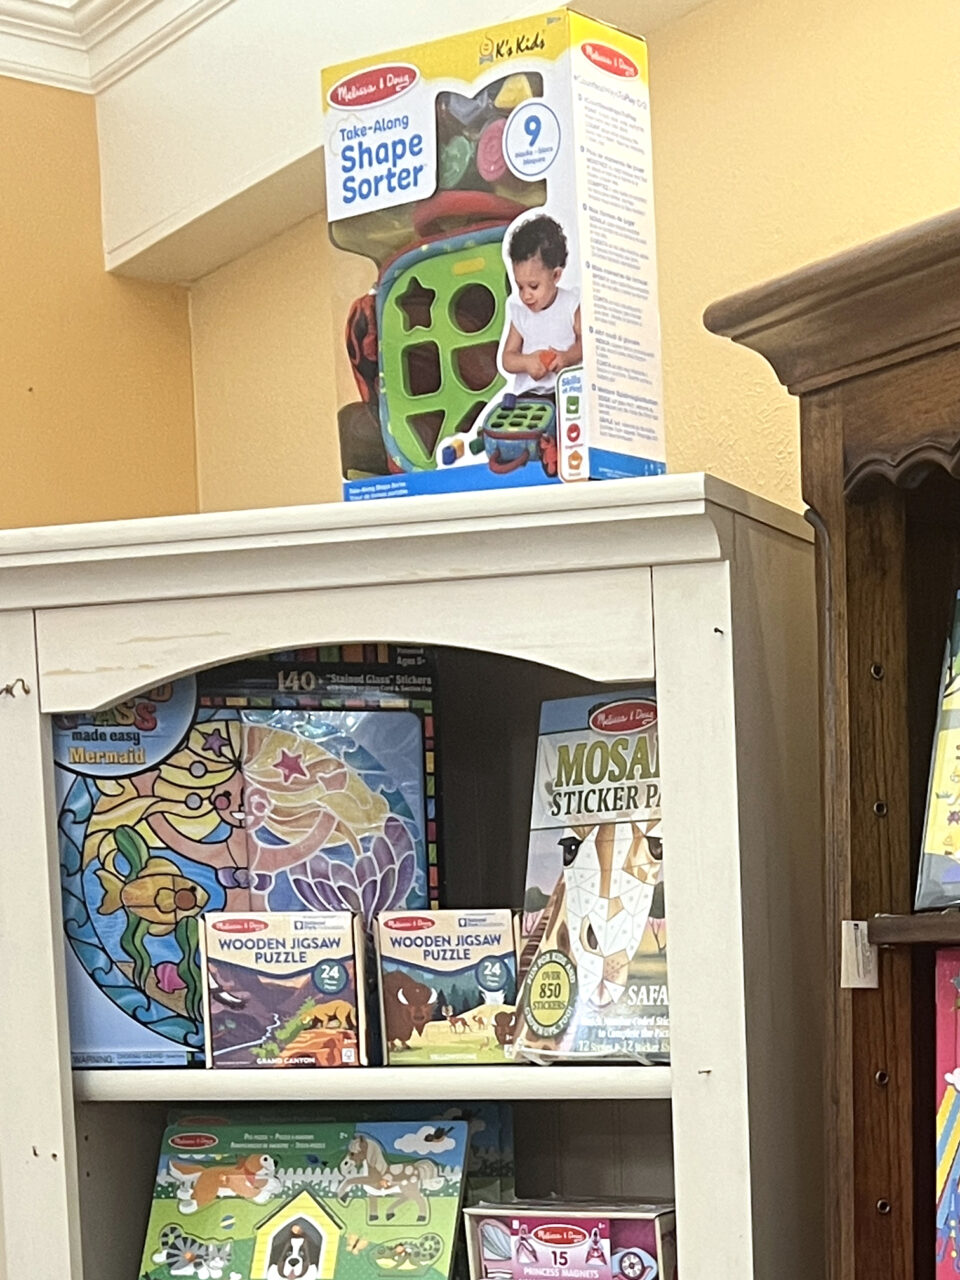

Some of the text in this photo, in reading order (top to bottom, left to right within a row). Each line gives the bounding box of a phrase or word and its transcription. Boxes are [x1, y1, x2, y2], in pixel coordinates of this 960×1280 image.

[495, 33, 545, 58] K's Kids
[337, 84, 376, 103] Melissa
[386, 73, 410, 91] Doug
[339, 115, 409, 142] Take-Along
[524, 115, 541, 147] 9
[341, 134, 423, 174] Shape
[342, 164, 424, 204] Sorter
[278, 670, 316, 692] 140
[72, 730, 140, 745] made easy
[69, 748, 145, 764] Mermaid
[552, 784, 661, 816] STICKER P
[219, 938, 341, 950] WOODEN JIGSAW
[390, 934, 501, 948] WOODEN JIGSAW
[255, 952, 307, 964] PUZZLE
[423, 949, 470, 961] PUZZLE
[321, 965, 340, 979] 24
[484, 963, 500, 975] 24
[540, 983, 561, 998] 850
[551, 1251, 568, 1265] 15
